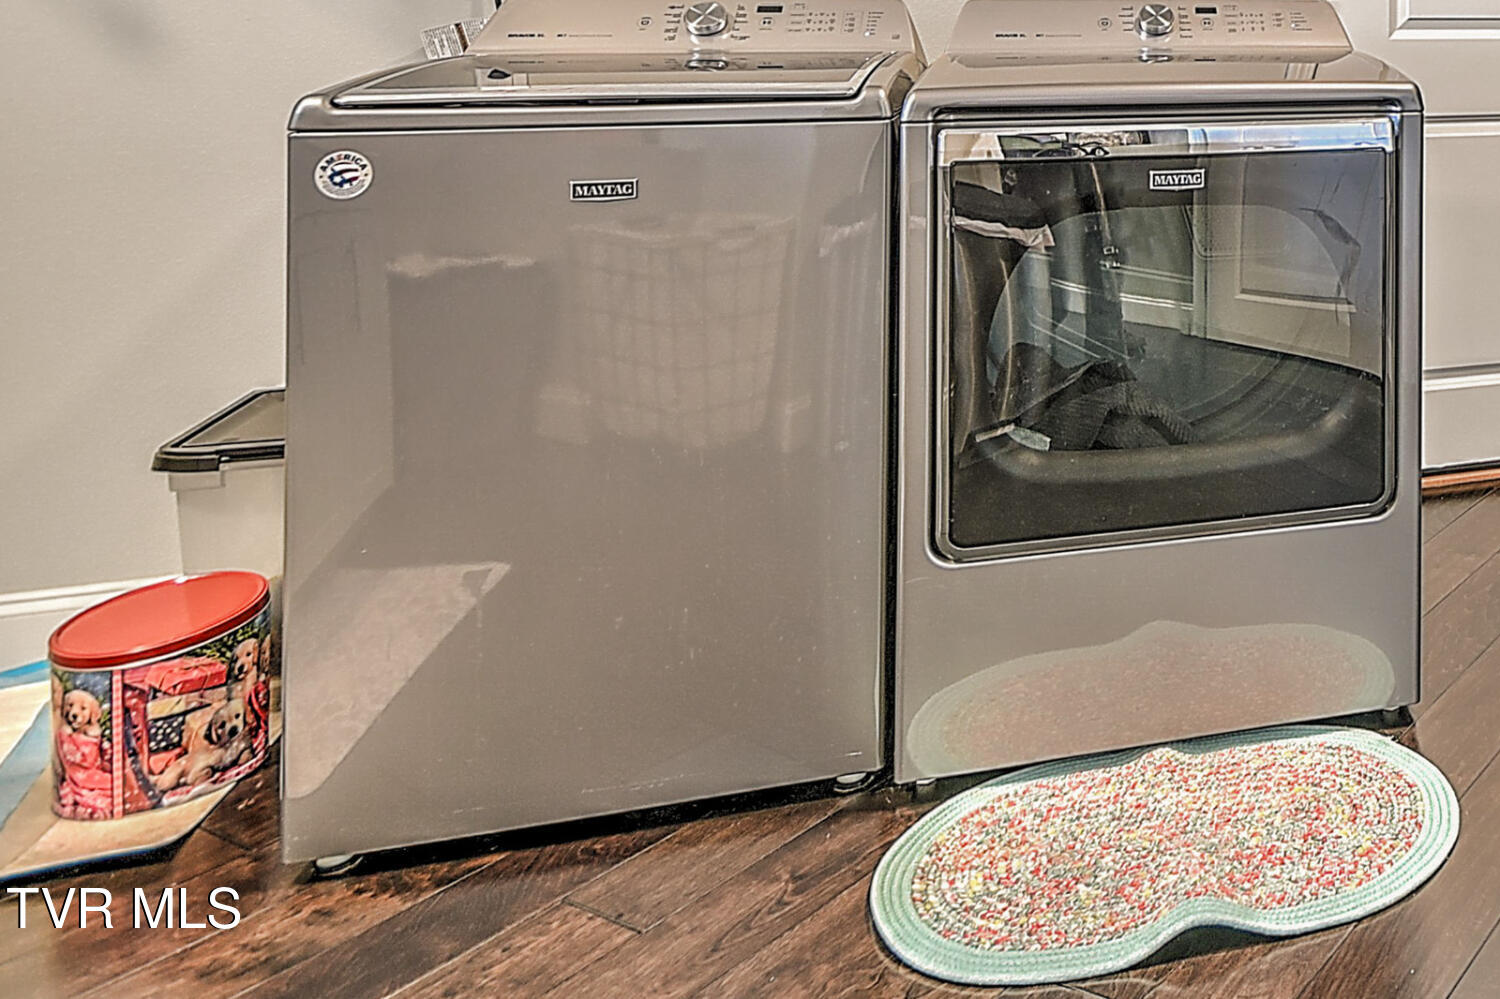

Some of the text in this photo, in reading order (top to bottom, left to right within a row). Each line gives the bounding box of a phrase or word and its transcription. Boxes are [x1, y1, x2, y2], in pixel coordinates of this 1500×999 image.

[320, 154, 368, 172] AMERICA
[1153, 173, 1202, 186] MAYTAG
[574, 183, 633, 197] MAYTAG
